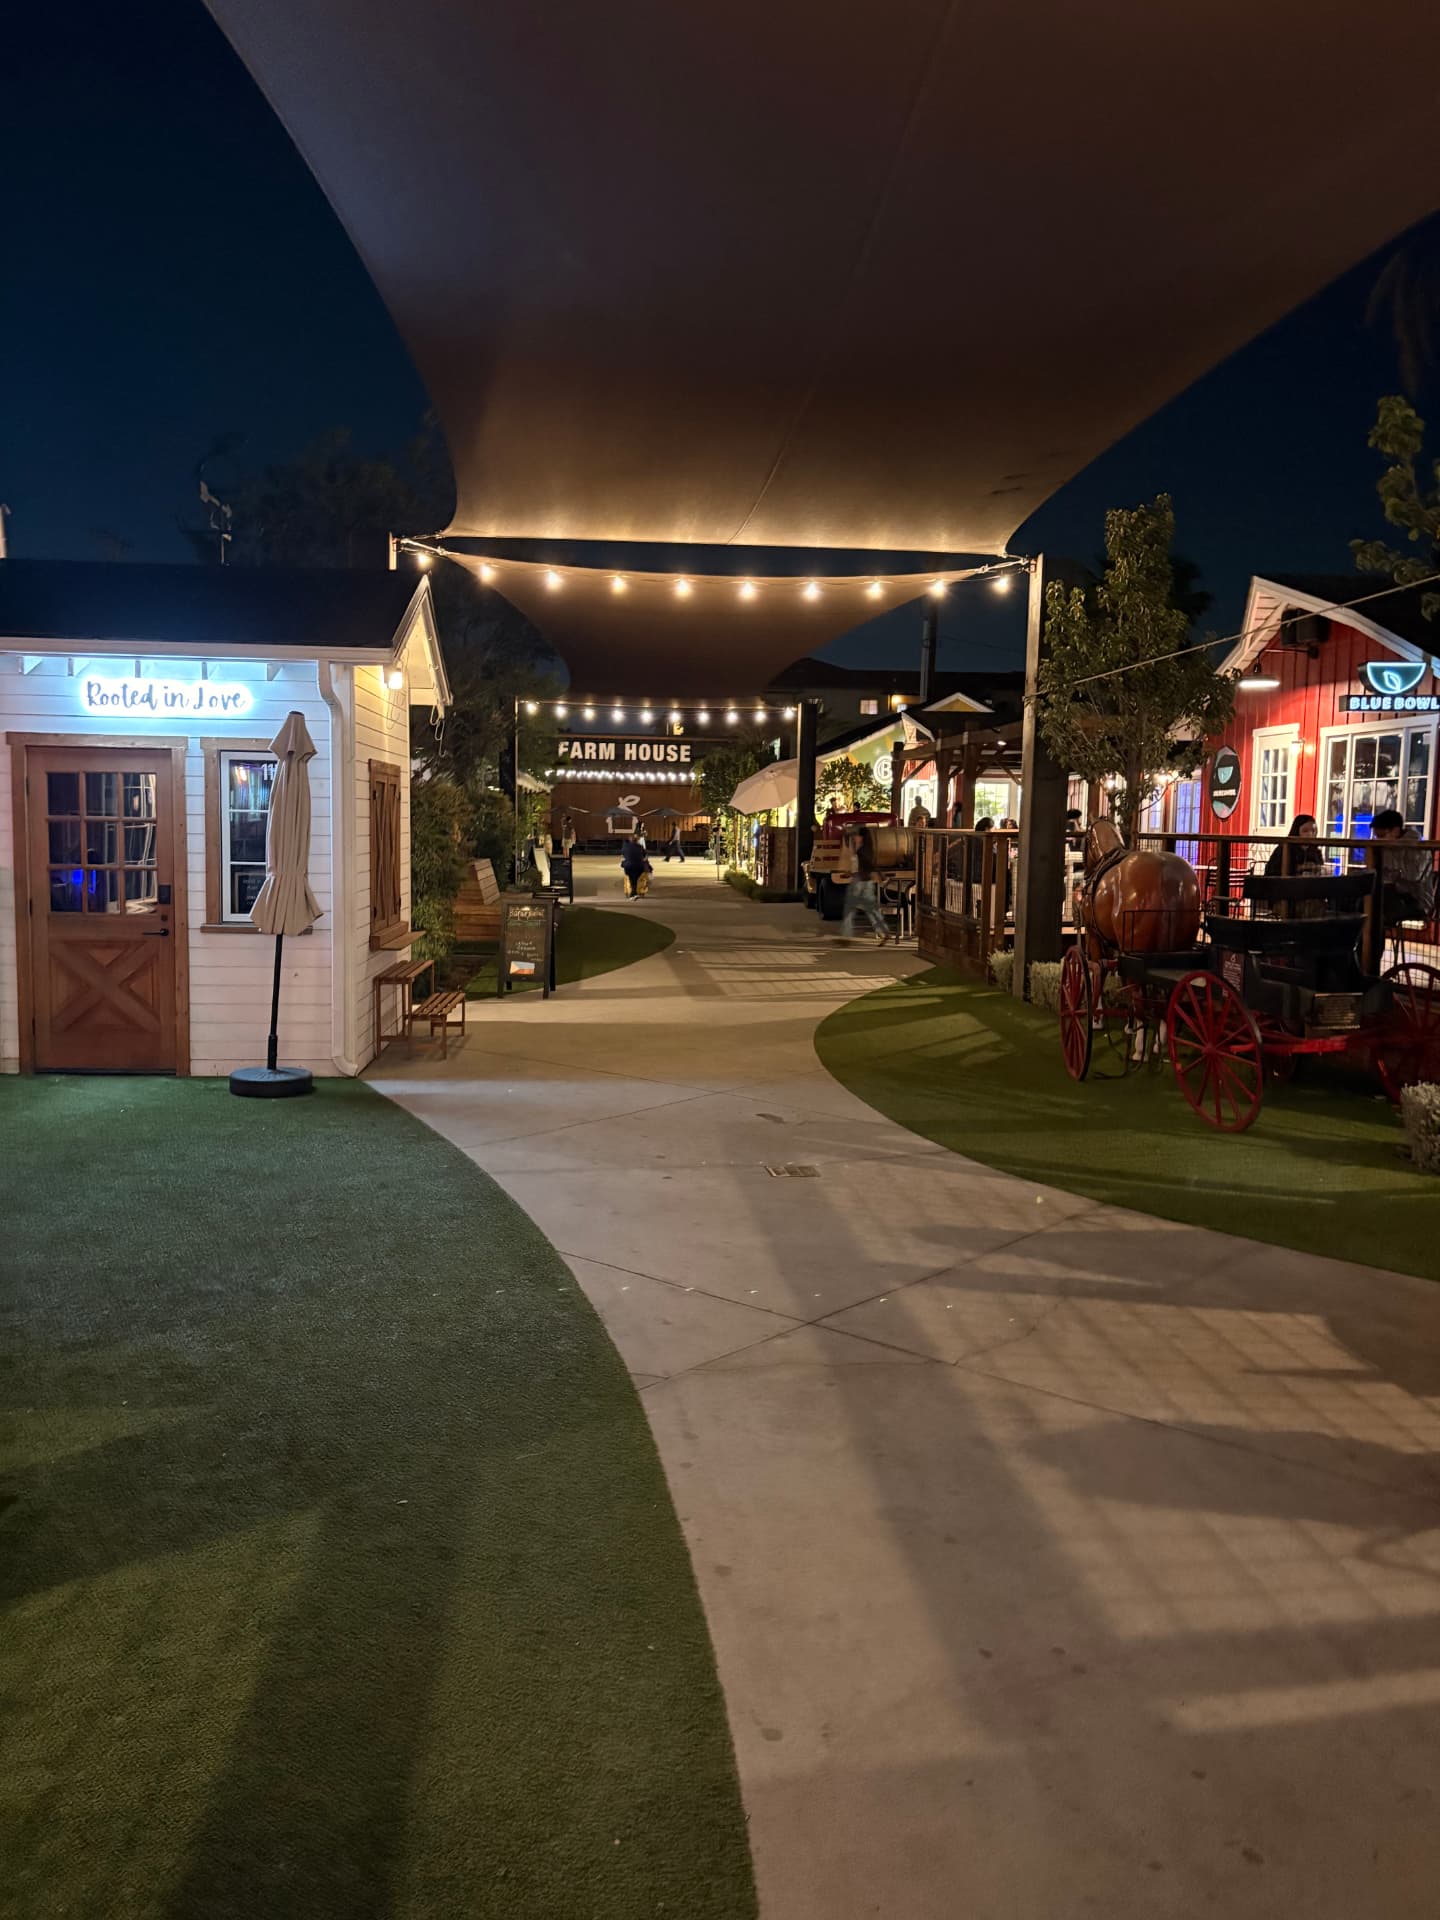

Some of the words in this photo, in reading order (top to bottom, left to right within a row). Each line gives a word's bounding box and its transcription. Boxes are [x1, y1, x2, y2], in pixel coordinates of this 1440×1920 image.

[87, 681, 158, 710] Rooted
[163, 686, 190, 708] in
[193, 687, 246, 710] Love
[1349, 697, 1391, 710] BLUE
[1394, 697, 1440, 710] BOWL
[558, 741, 616, 761] FARM
[624, 743, 691, 763] HOUSE
